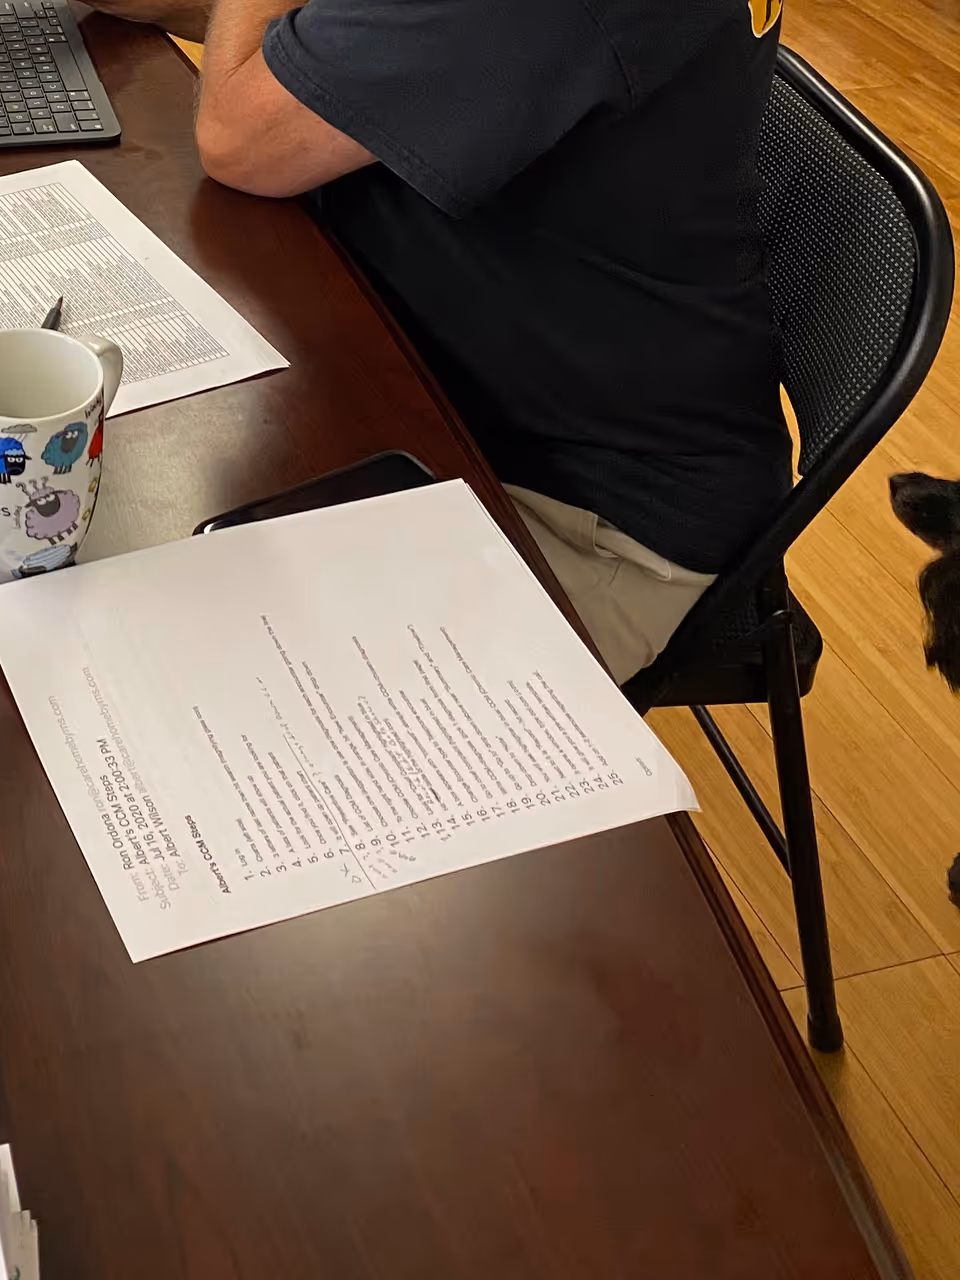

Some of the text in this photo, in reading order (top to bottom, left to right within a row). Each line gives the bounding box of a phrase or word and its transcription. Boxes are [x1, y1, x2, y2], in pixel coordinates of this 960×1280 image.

[578, 777, 595, 794] 23.
[593, 773, 610, 790] 24.
[607, 769, 624, 786] 25.
[535, 789, 552, 807] 20.
[550, 785, 567, 802] 21.
[564, 782, 581, 799] 22.
[490, 801, 506, 818] 17.
[506, 798, 521, 814] 18.
[520, 793, 536, 810] 19.
[96, 738, 180, 891] Date: Jul 16, 2020 at 2:00:33 PM
[142, 795, 164, 828] Wilson
[460, 810, 476, 827] 15.
[476, 805, 491, 822] 16.
[101, 813, 124, 849] Ordona
[385, 830, 400, 848] 10.
[416, 822, 431, 839] 12.
[99, 774, 171, 910] Subject: Albert's CCM Steps
[158, 828, 181, 857] Albert
[354, 839, 366, 851] 8.
[370, 834, 382, 847] 9.
[184, 814, 232, 894] Albert's CCM Steps
[306, 852, 319, 864] 5.
[323, 847, 335, 859] 6.
[338, 843, 353, 856] 7.
[119, 849, 135, 871] Ron
[175, 859, 189, 876] To:
[238, 854, 249, 868] Log
[275, 861, 288, 873] 3.
[291, 856, 302, 868] 4.
[244, 870, 255, 881] 1.
[259, 865, 272, 878] 2.
[130, 872, 150, 902] From:
